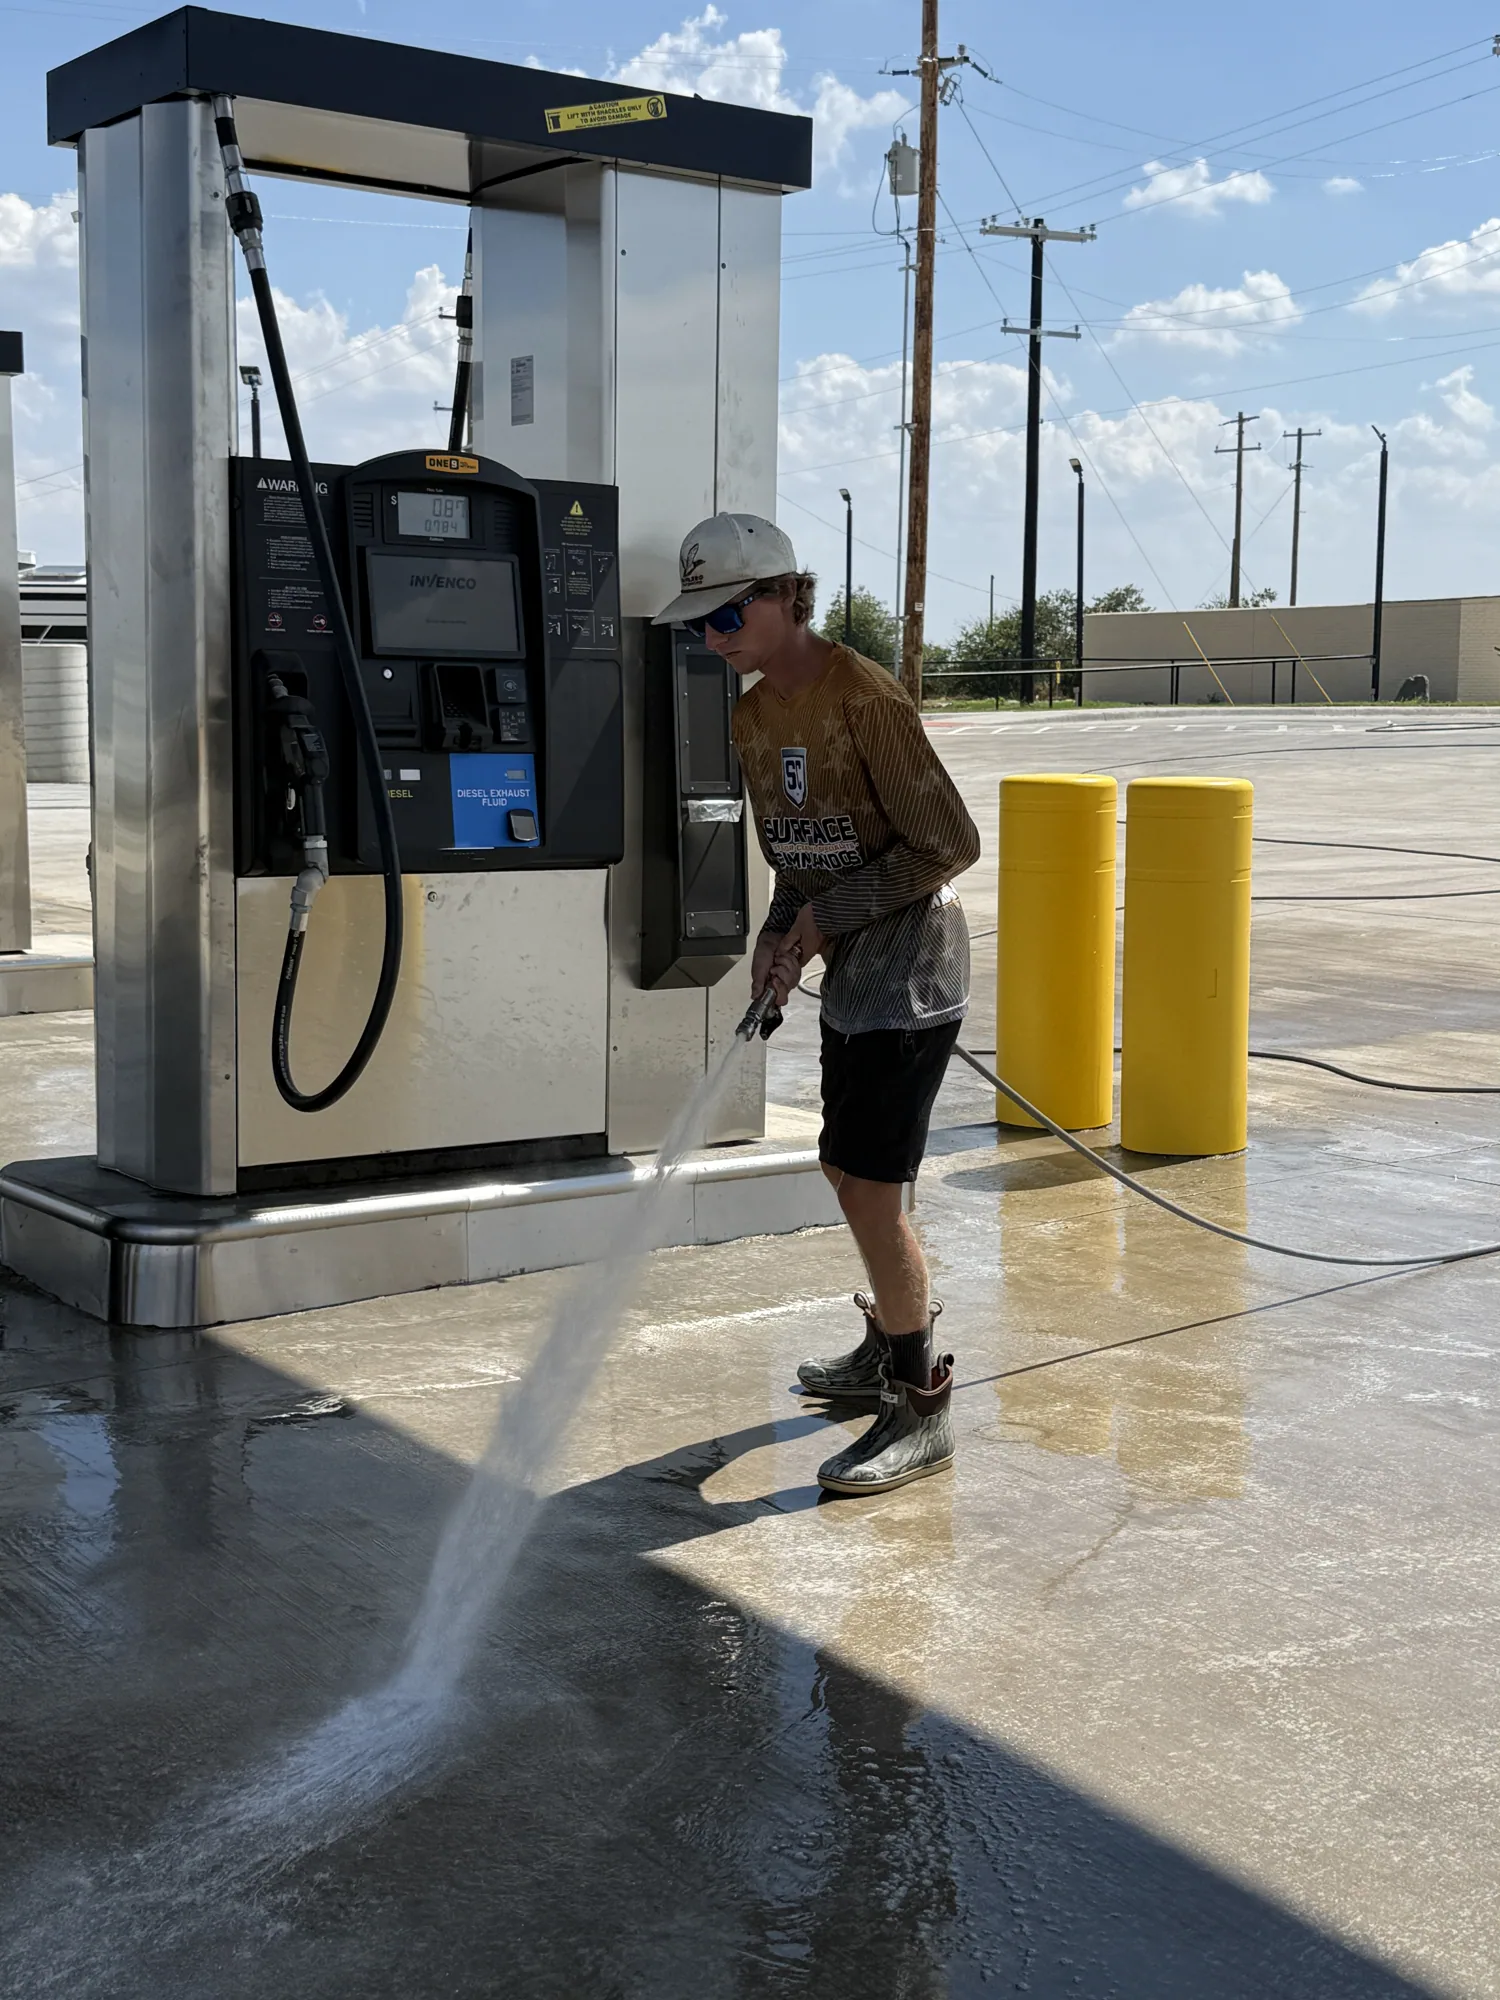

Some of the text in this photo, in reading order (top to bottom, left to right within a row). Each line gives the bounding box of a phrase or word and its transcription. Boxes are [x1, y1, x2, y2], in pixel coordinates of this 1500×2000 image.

[580, 110, 596, 118] WITH
[597, 107, 627, 116] SHACKLES
[627, 104, 642, 112] ONLY
[594, 102, 619, 110] CAUTION
[589, 115, 607, 123] AVOID
[607, 112, 632, 121] DAMAGE
[409, 573, 477, 590] INVENCO
[457, 789, 530, 798] DIESEL EXHAUST
[482, 798, 507, 806] FLUID
[763, 815, 858, 845] SURFACE
